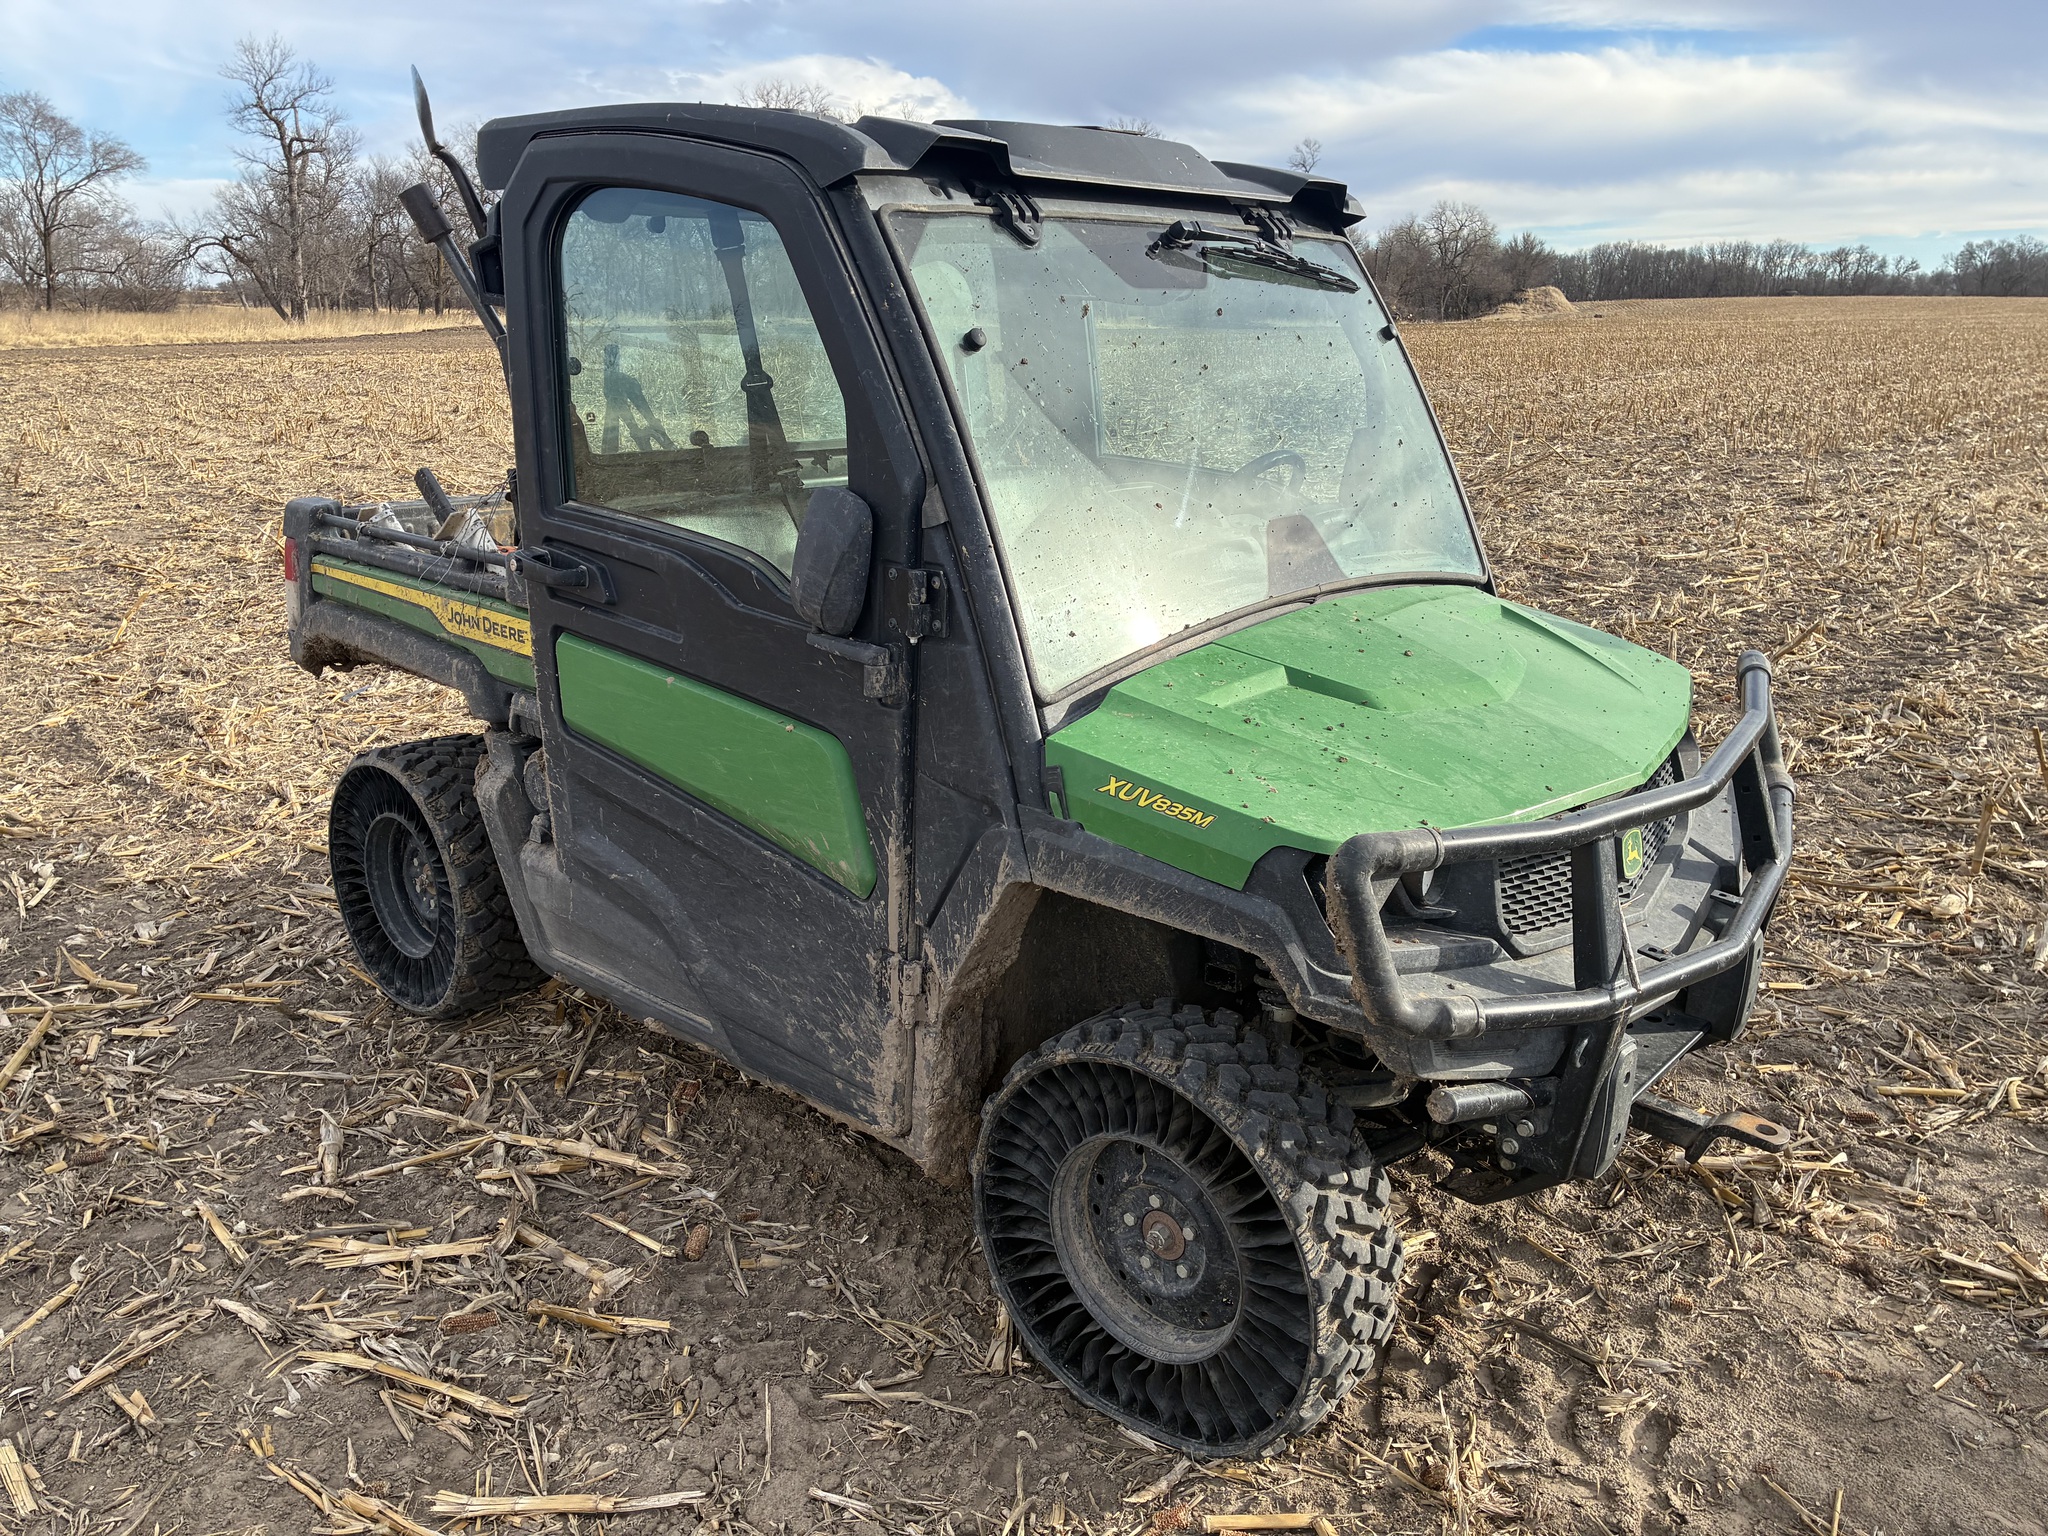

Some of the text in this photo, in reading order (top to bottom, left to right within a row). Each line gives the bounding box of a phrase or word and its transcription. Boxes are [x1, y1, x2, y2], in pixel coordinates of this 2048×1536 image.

[447, 607, 527, 644] JOHN DEERE
[1095, 774, 1218, 829] XUV835M
[1124, 1335, 1171, 1360] MICHELIN
